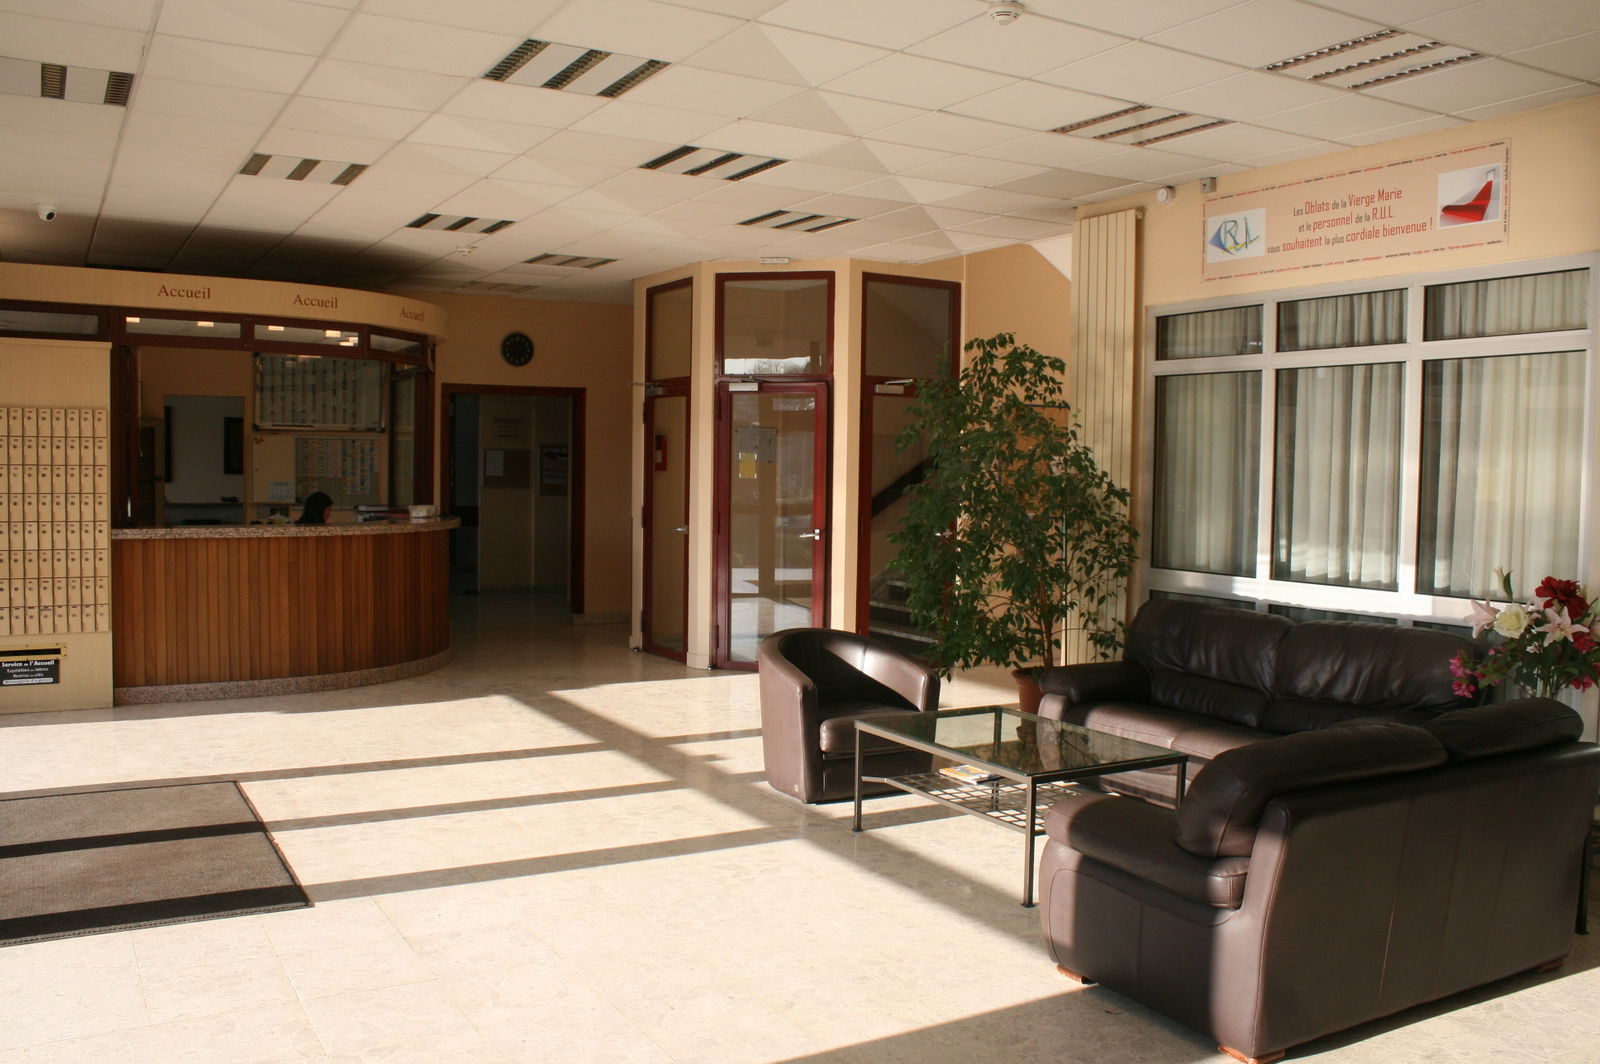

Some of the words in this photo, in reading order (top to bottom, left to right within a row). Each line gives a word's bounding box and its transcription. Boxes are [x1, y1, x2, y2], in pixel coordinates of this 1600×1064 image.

[1293, 207, 1304, 217] Les
[1305, 200, 1330, 215] Oblats
[1331, 199, 1340, 210] de
[1340, 198, 1347, 209] la
[1348, 192, 1376, 207] Vierge
[1377, 188, 1402, 201] Marie
[1298, 222, 1305, 233] et
[1305, 220, 1312, 231] le
[1312, 211, 1353, 232] personnel
[1354, 213, 1363, 224] de
[1364, 211, 1371, 222] la
[1267, 244, 1281, 254] vous
[1282, 236, 1323, 252] souhaitent
[1324, 235, 1331, 245] la
[1331, 234, 1345, 246] plus
[1345, 227, 1380, 243] cordiale
[1382, 220, 1427, 238] bienvenue
[157, 284, 211, 300] Accueil
[293, 293, 339, 309] Accueil
[400, 307, 425, 322] Accueil
